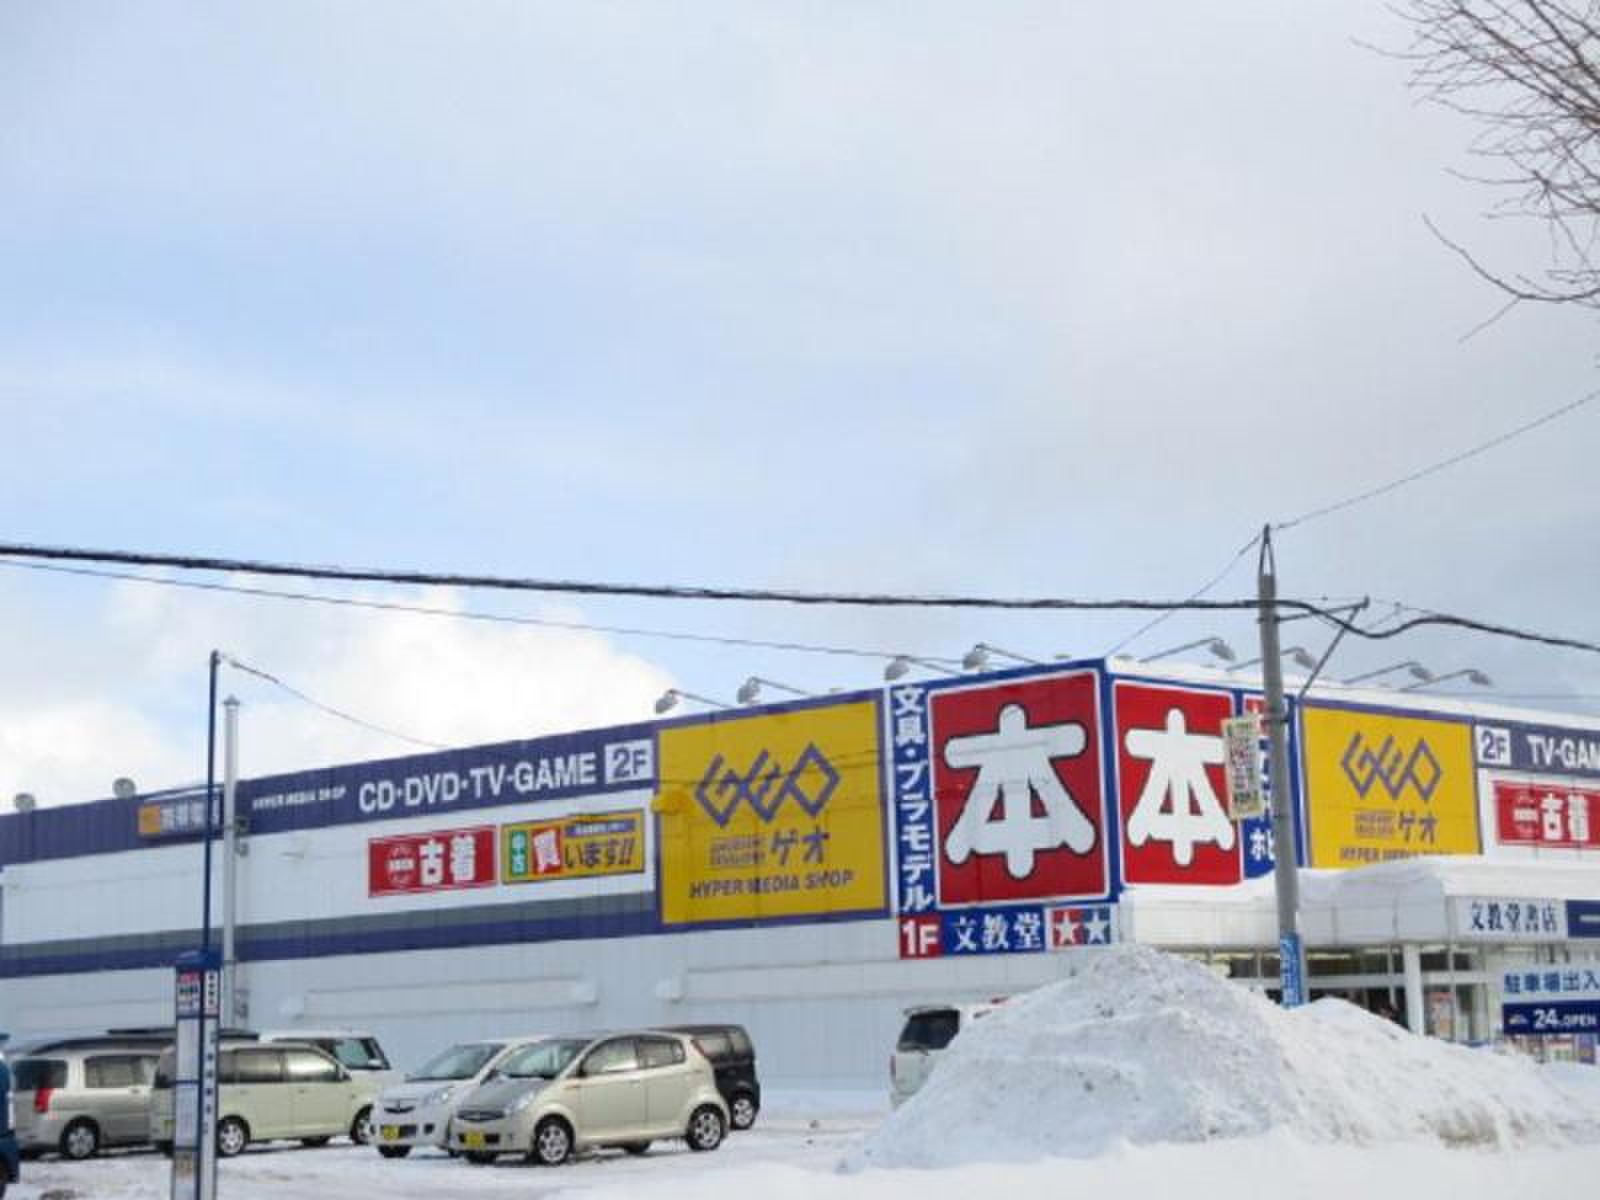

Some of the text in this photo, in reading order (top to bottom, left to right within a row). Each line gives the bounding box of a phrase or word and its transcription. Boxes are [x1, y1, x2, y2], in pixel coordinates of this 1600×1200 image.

[612, 747, 648, 778] 2F
[1481, 729, 1507, 760] 2F
[695, 740, 841, 827] GEO
[1341, 731, 1443, 804] GEO
[319, 785, 347, 801] SHOP
[895, 687, 932, 911] 文具・プラモデル
[943, 703, 1096, 879] 本
[1124, 708, 1235, 866] 本
[771, 825, 830, 866] ゲオ
[1399, 808, 1437, 845] ゲオ
[418, 834, 476, 885] 古着
[690, 869, 854, 898] HYPER MEDIA SHOP
[955, 912, 1041, 950] 文教堂
[1471, 902, 1558, 932] 文教堂書店
[901, 920, 939, 955] 1F
